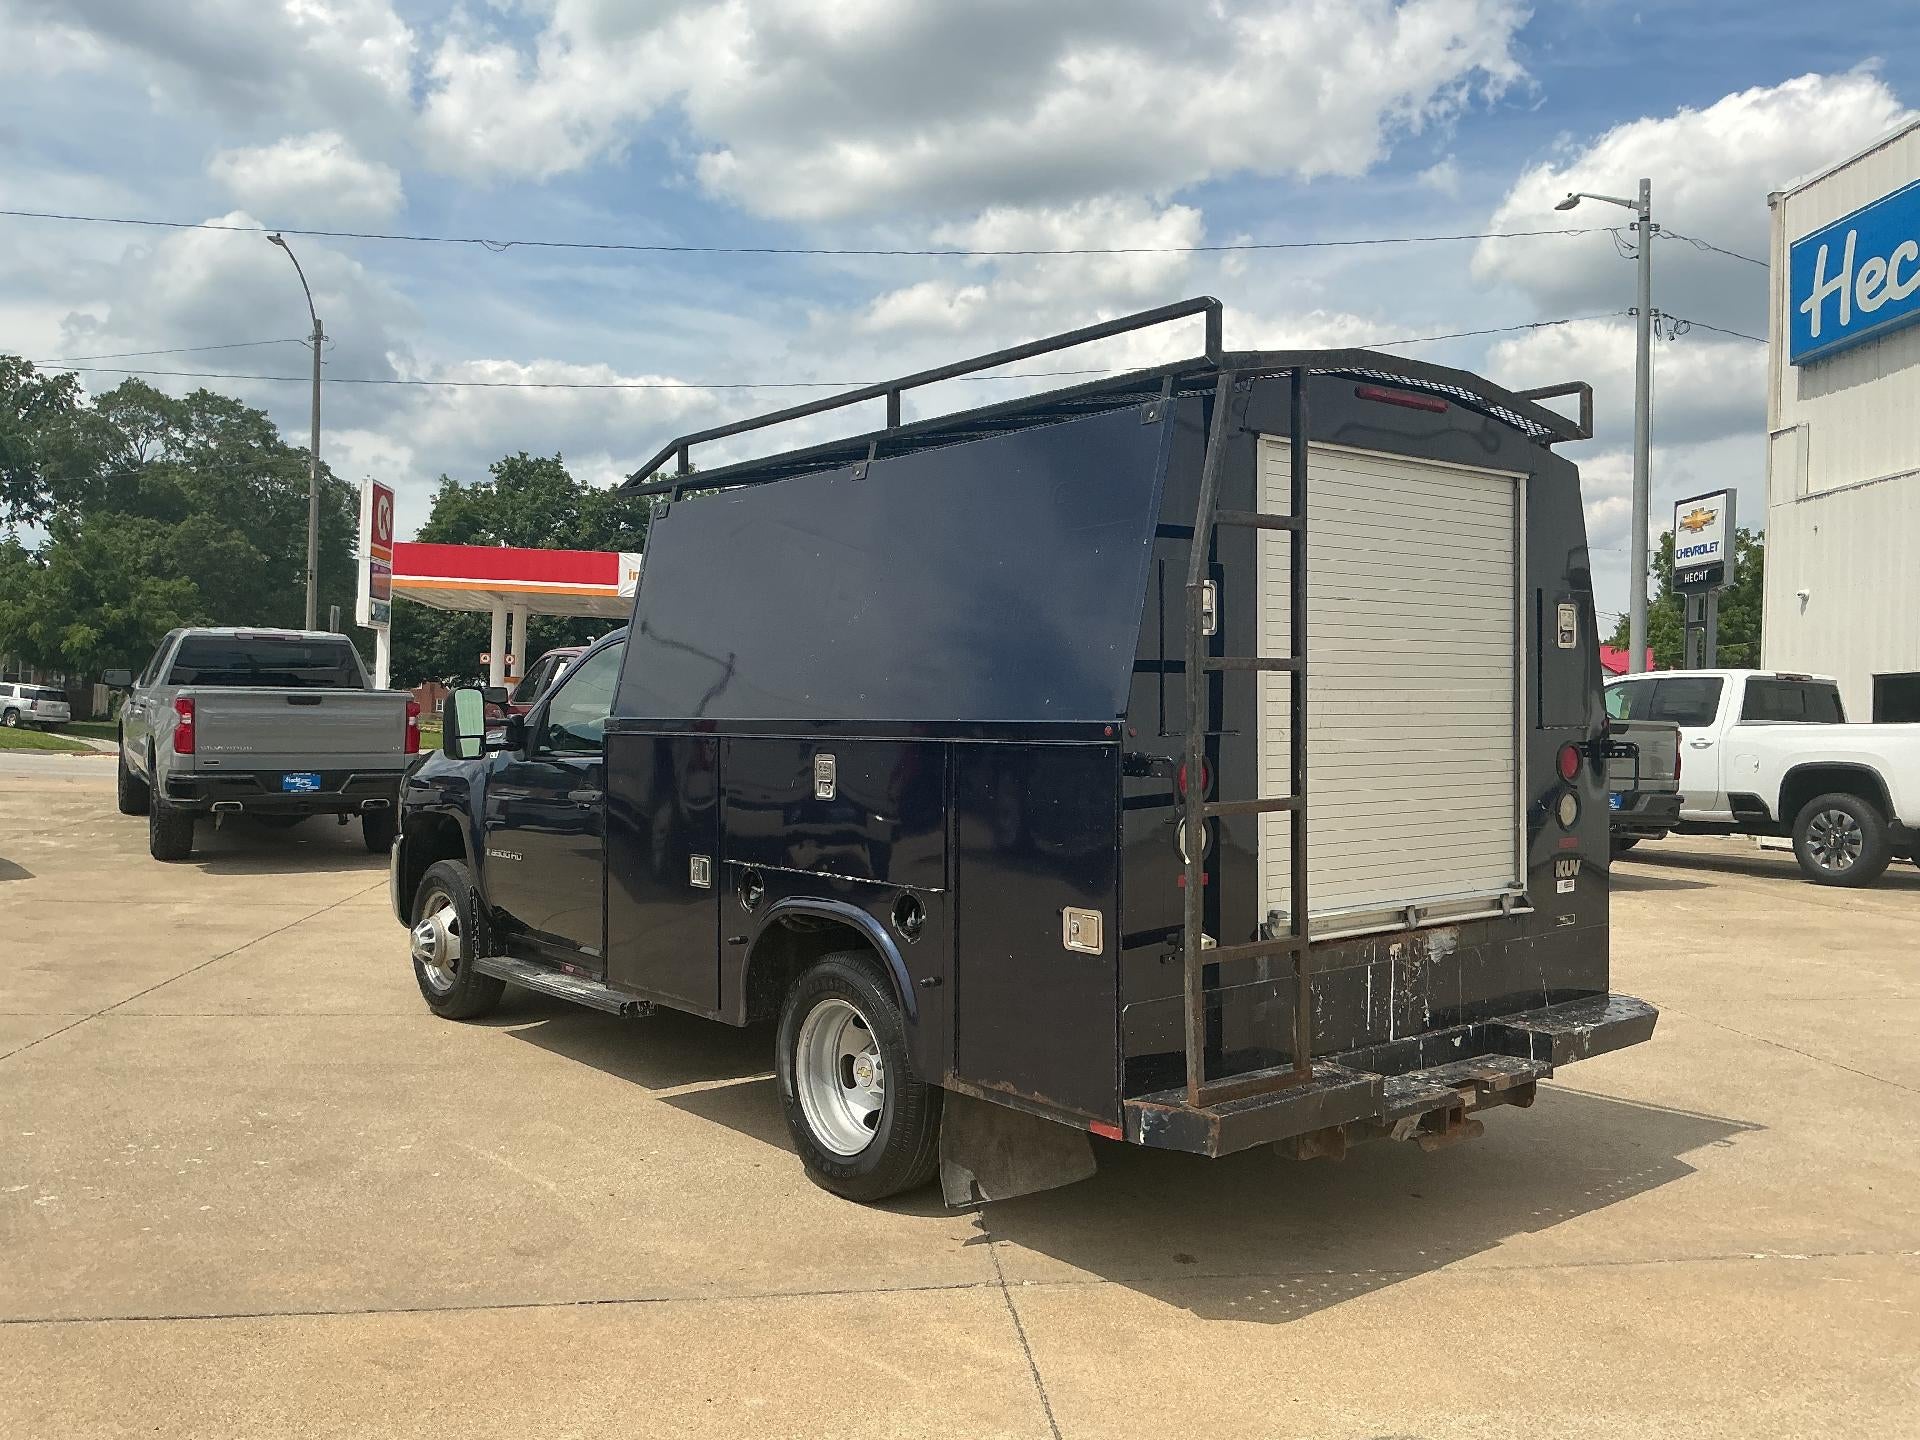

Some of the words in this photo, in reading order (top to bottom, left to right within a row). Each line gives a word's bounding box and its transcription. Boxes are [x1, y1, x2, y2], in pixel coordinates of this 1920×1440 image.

[1675, 541, 1720, 560] CHEVROLET
[1684, 570, 1709, 584] HECHT
[1555, 859, 1582, 878] KUV
